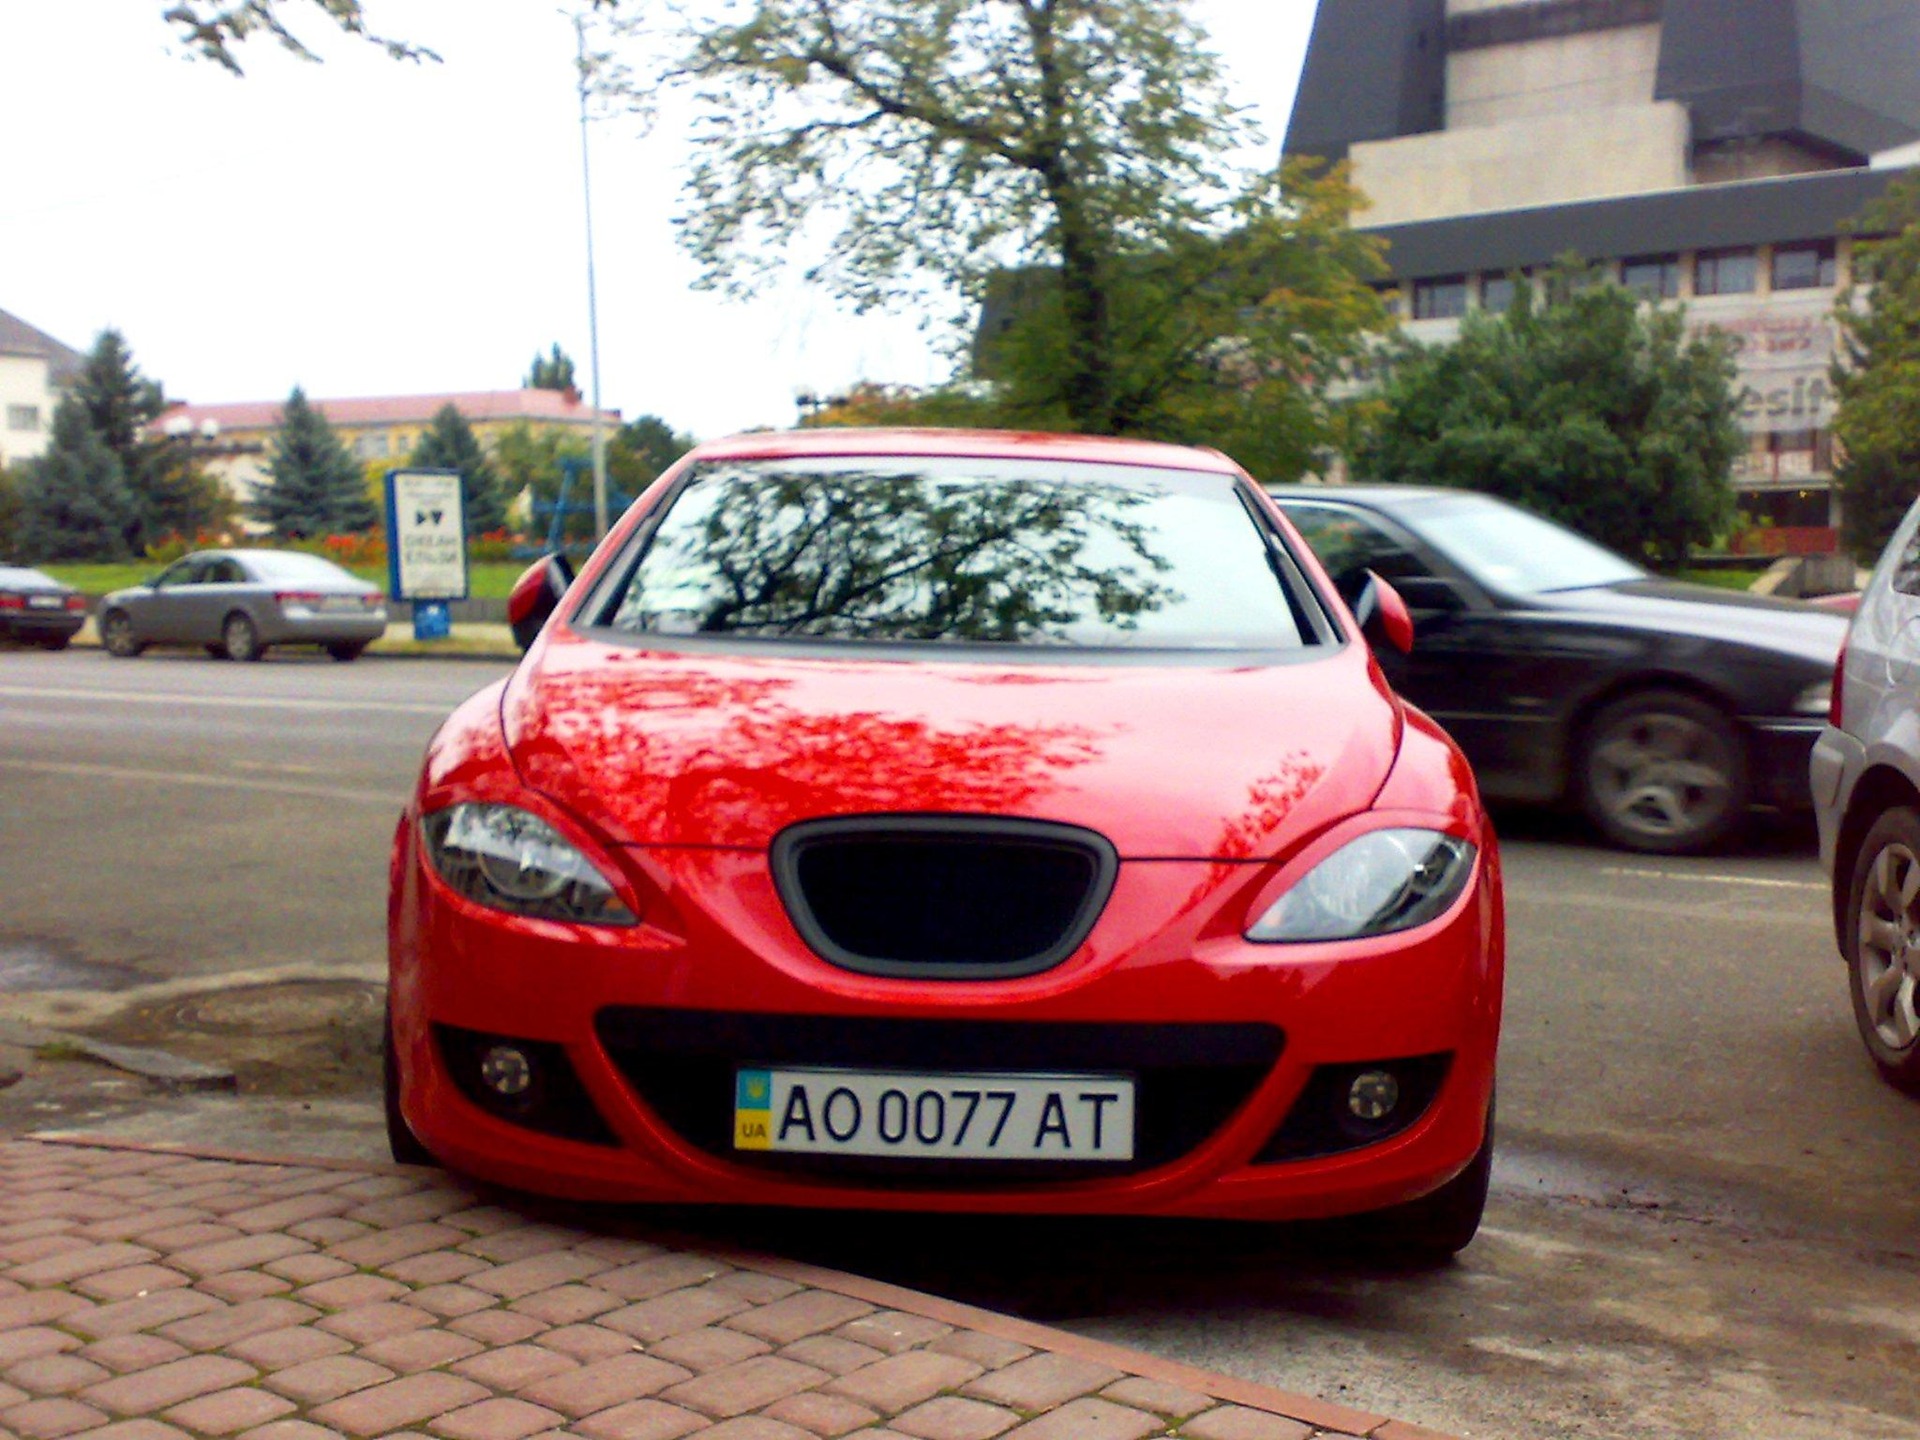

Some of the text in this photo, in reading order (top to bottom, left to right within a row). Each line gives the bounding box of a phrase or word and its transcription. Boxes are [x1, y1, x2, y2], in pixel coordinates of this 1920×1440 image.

[742, 1124, 767, 1139] UA
[778, 1084, 1119, 1149] AO 0077 AT
